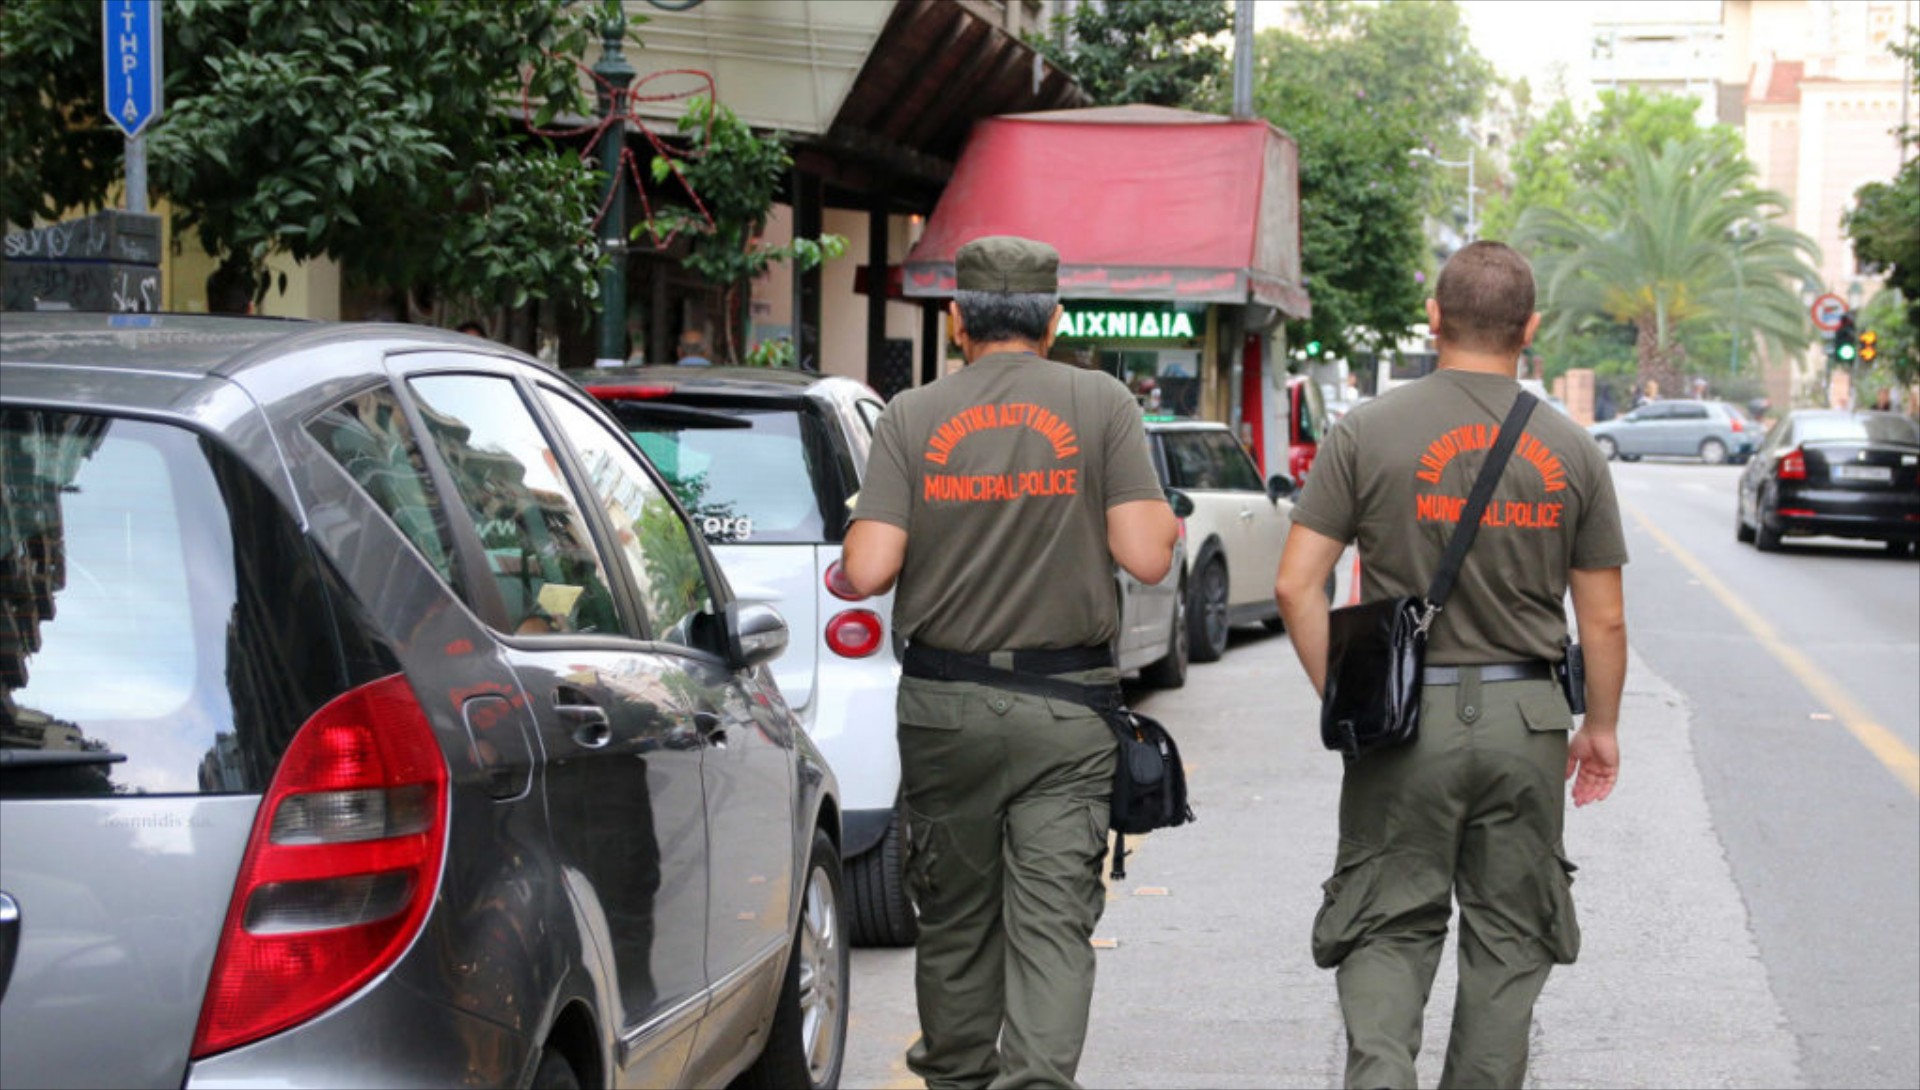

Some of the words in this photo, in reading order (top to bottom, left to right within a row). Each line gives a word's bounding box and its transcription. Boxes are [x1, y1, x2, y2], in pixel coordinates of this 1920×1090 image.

[1056, 311, 1194, 338] ΑΙΧΝΙΔΙΑ
[1489, 423, 1567, 492] ΑΥΝΟΜΙΑ
[924, 472, 1021, 501] MUNICIPAL
[1019, 469, 1078, 497] POLICE
[1416, 493, 1504, 527] MUNICAL
[1505, 501, 1563, 528] POLICE
[703, 517, 752, 540] org
